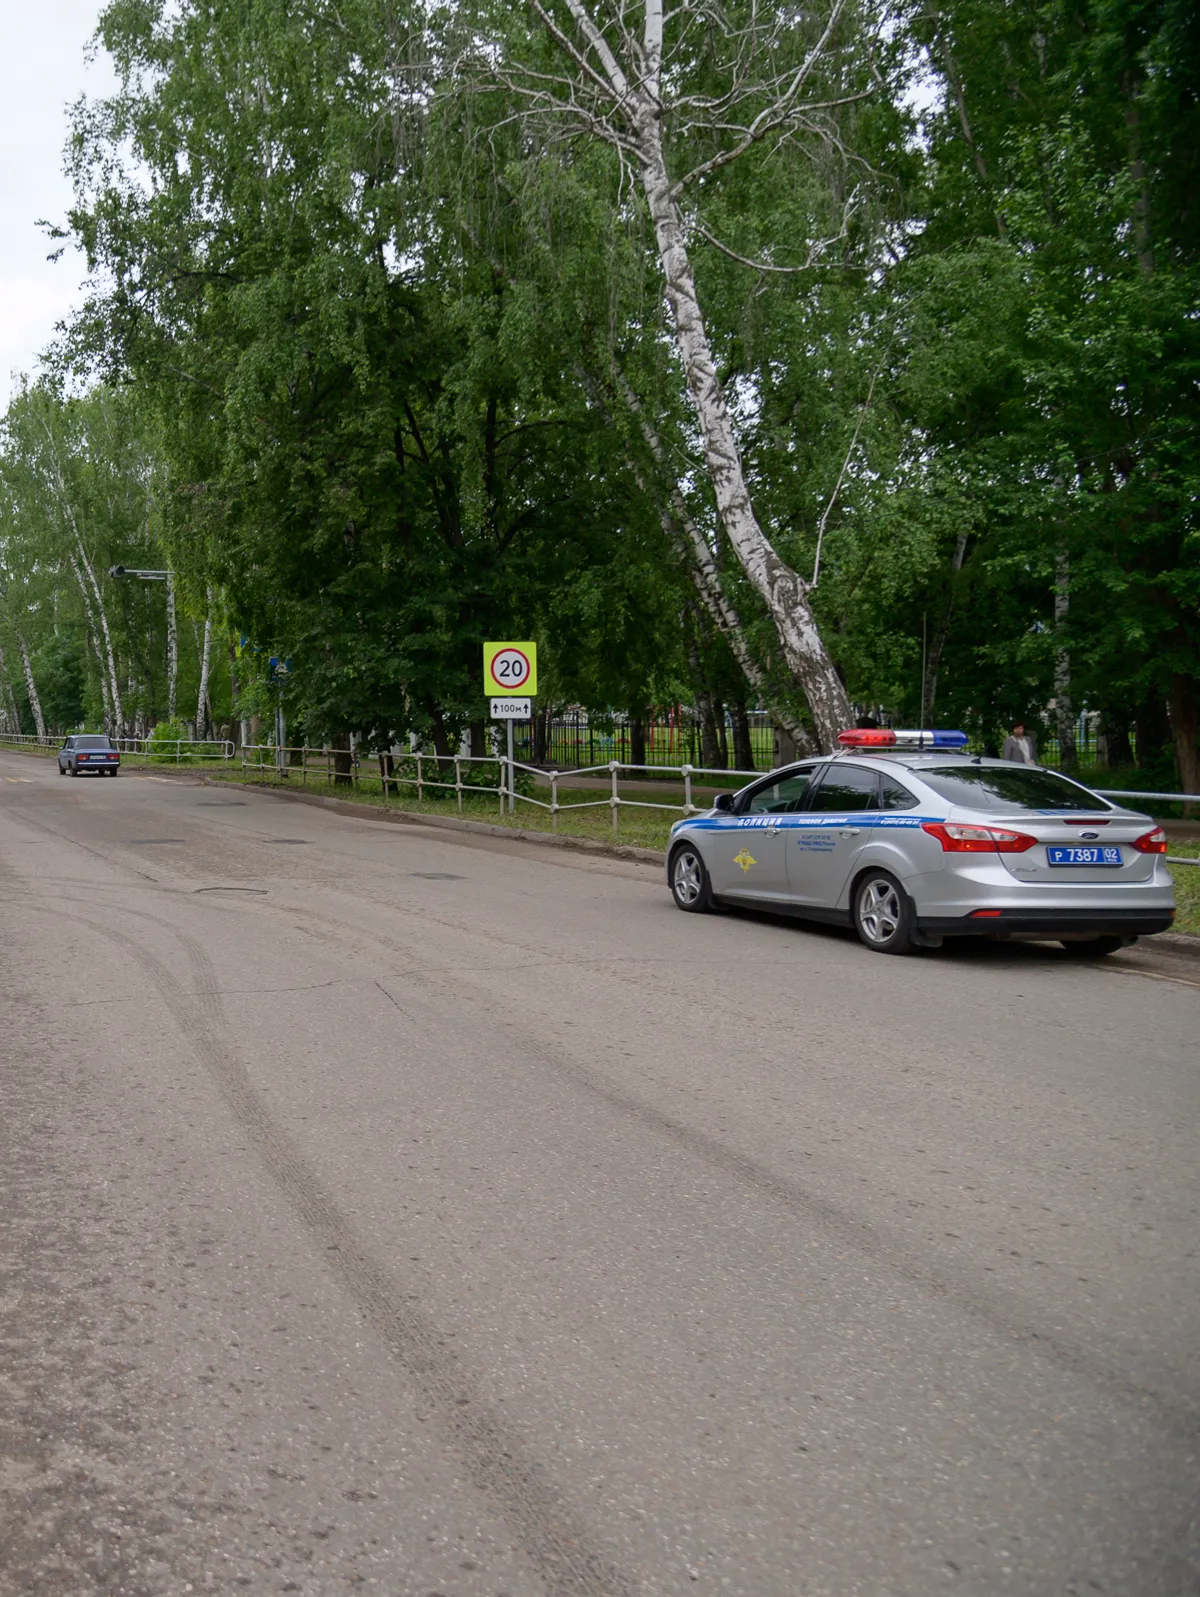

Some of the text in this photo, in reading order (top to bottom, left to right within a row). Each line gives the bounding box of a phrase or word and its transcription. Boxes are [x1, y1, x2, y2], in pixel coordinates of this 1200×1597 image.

[499, 660, 523, 678] 20
[737, 817, 783, 827] ПОЛИЦИЯ
[1066, 848, 1098, 861] 7387
[1105, 848, 1118, 858] 02
